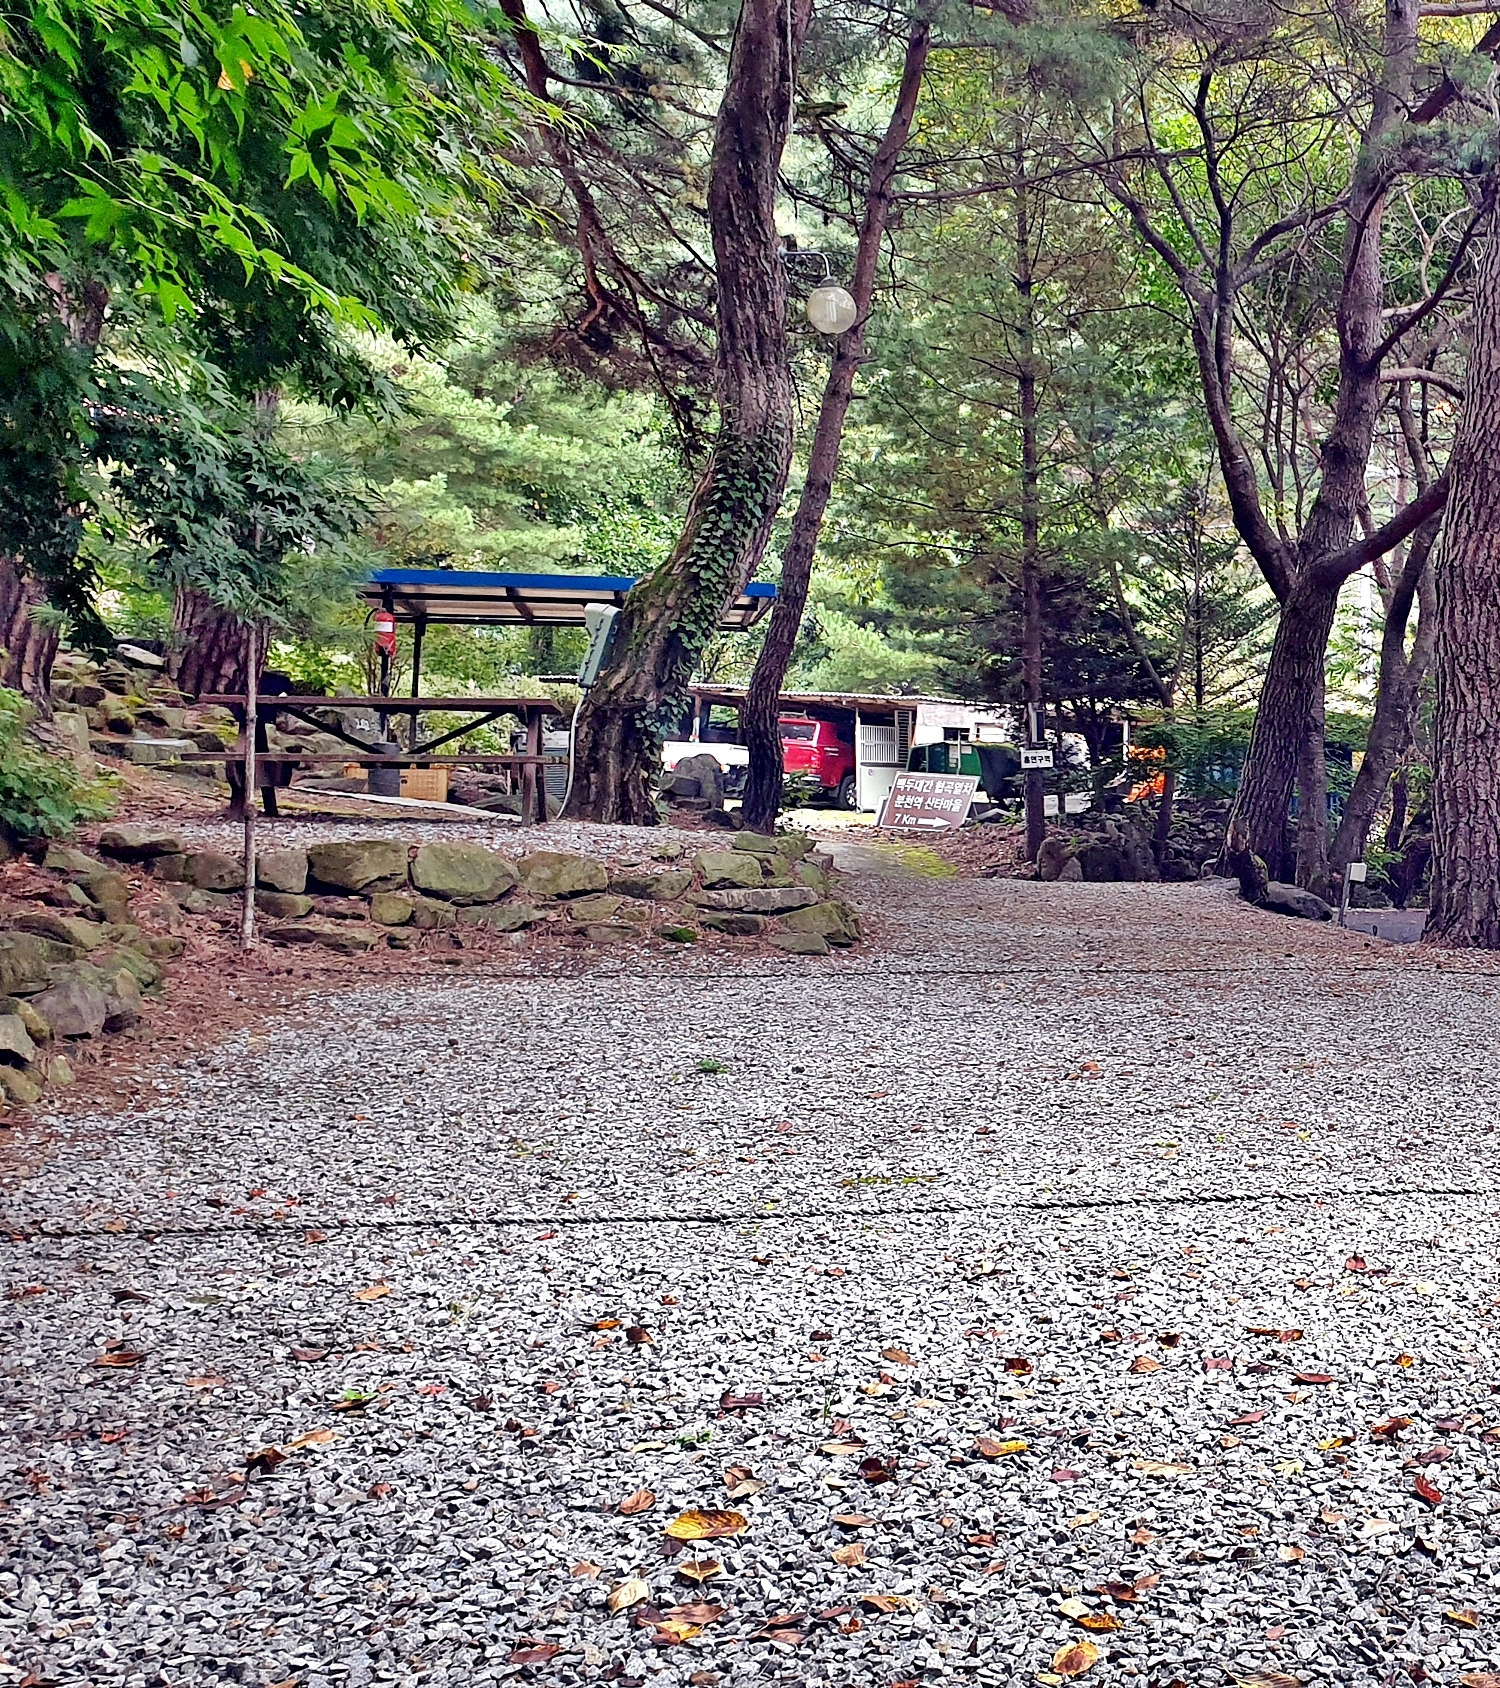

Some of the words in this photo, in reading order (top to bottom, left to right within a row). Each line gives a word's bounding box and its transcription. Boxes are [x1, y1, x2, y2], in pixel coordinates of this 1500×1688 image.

[896, 778, 934, 793] 백두대간
[935, 780, 974, 796] 협곡열차
[894, 794, 924, 810] 분천역
[924, 796, 963, 812] 산타마을
[893, 813, 902, 824] 7
[902, 814, 917, 825] Km
